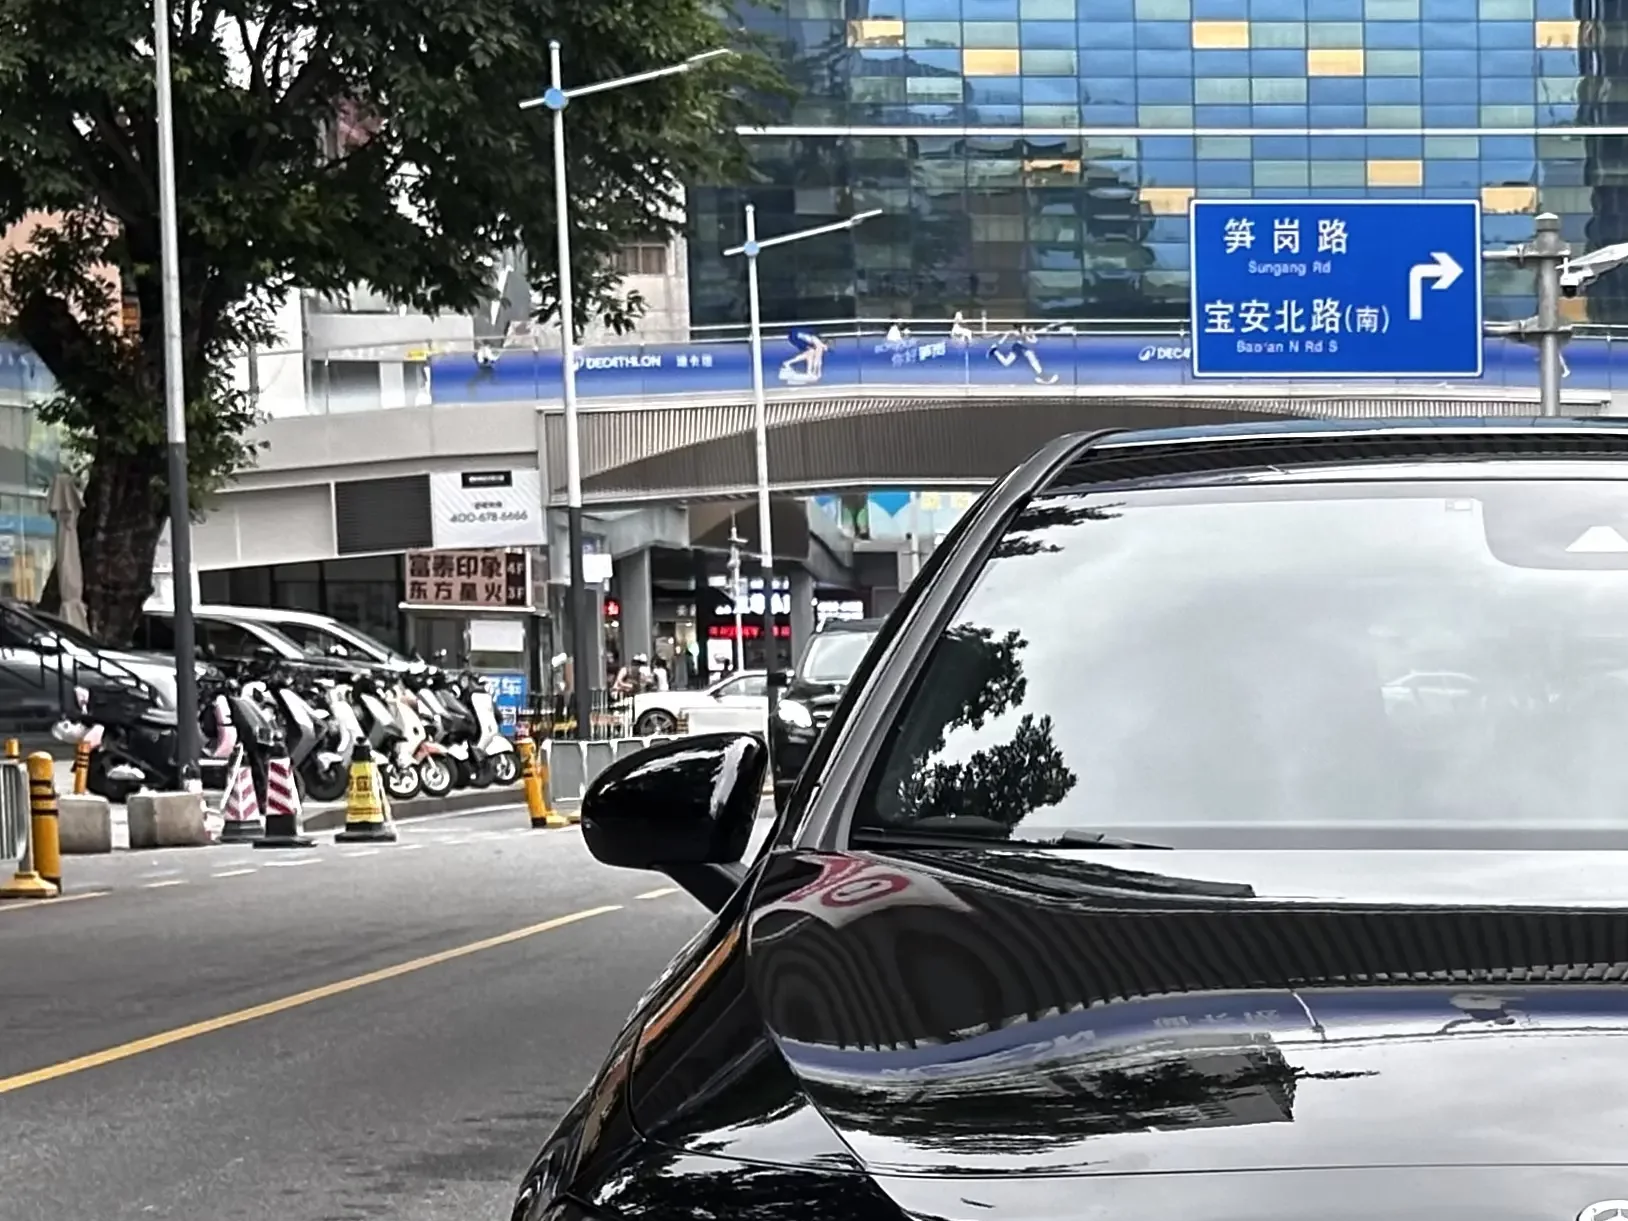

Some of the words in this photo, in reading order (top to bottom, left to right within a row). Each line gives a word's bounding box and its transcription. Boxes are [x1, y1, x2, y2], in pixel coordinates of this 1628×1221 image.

[1223, 218, 1349, 254] 笋岗路
[1248, 261, 1306, 276] Sungang
[1313, 260, 1332, 274] Rd
[1204, 298, 1390, 334] 宝安北路(南)
[1236, 340, 1283, 353] Bao'an
[1289, 341, 1299, 353] N
[1305, 341, 1323, 353] Rd
[1328, 341, 1338, 353] S
[586, 354, 661, 369] DECATHLON
